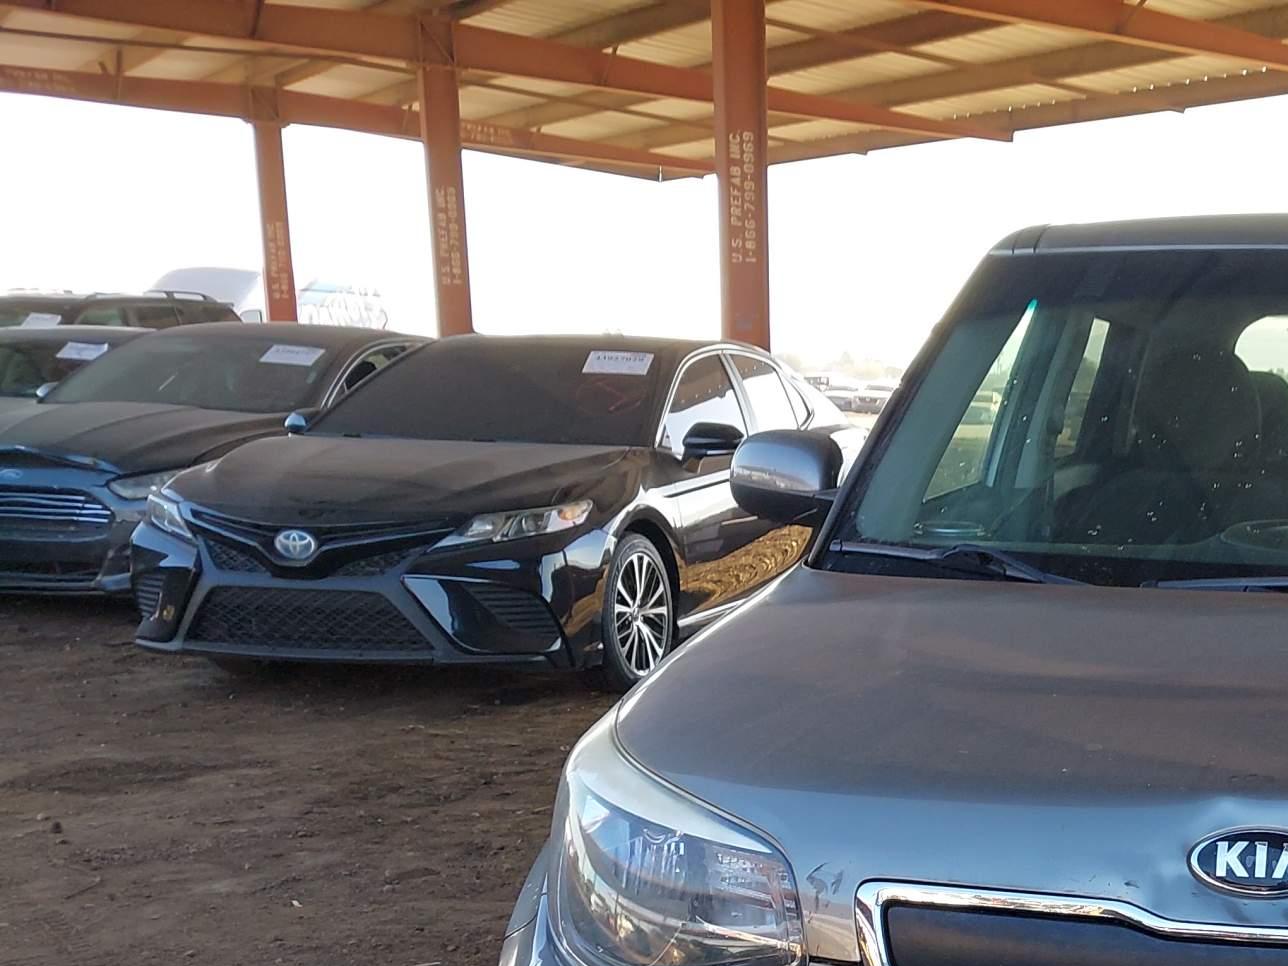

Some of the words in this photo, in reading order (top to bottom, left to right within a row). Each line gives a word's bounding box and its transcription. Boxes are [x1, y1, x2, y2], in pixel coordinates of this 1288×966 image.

[728, 130, 741, 160] INC.
[729, 165, 742, 226] PREFAB
[742, 131, 757, 263] 1-866-799-0969
[731, 236, 743, 264] U.S.
